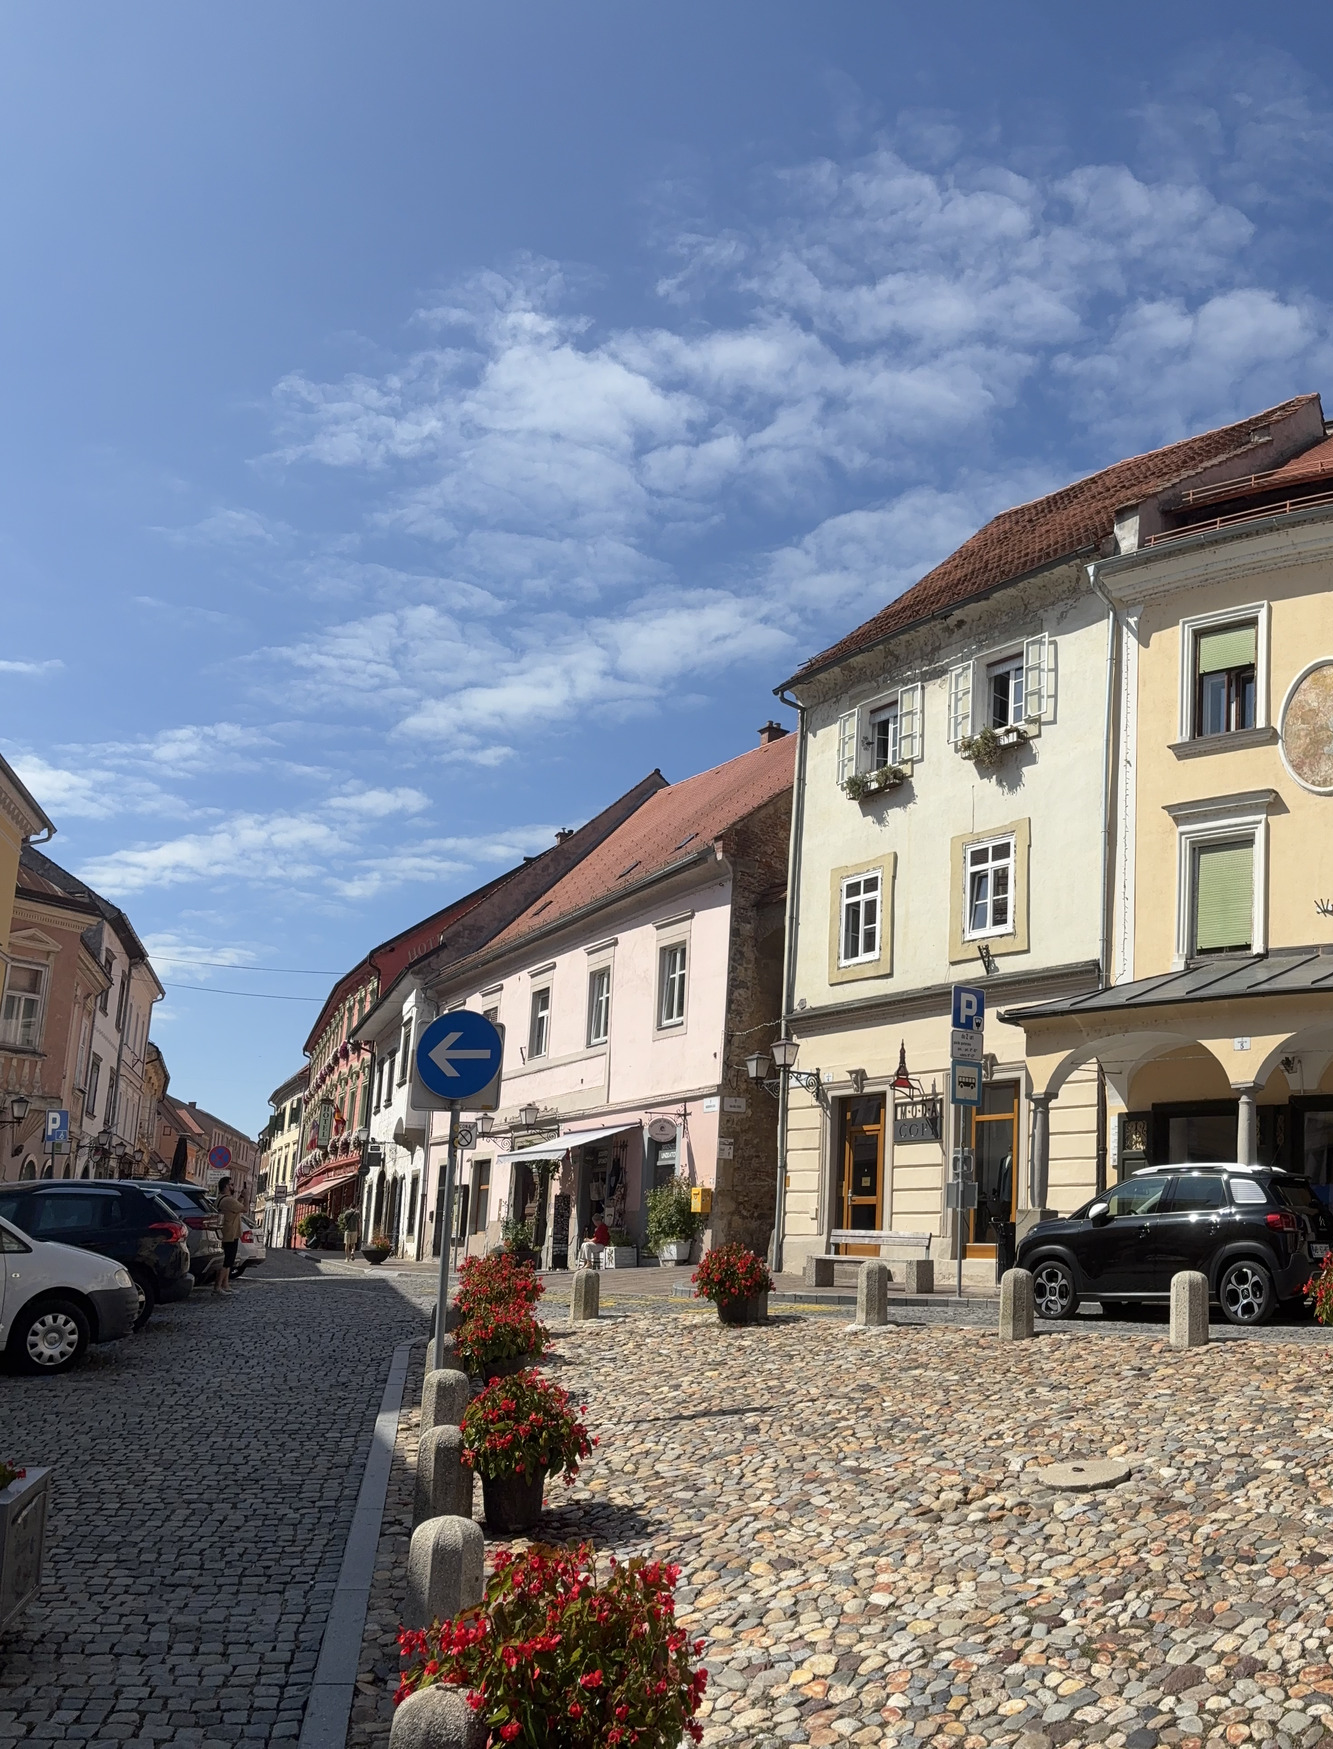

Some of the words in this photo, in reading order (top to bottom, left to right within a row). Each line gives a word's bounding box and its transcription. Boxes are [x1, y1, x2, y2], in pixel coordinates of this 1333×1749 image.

[959, 992, 977, 1024] P
[47, 1112, 61, 1136] P
[322, 1105, 330, 1138] HOTEL
